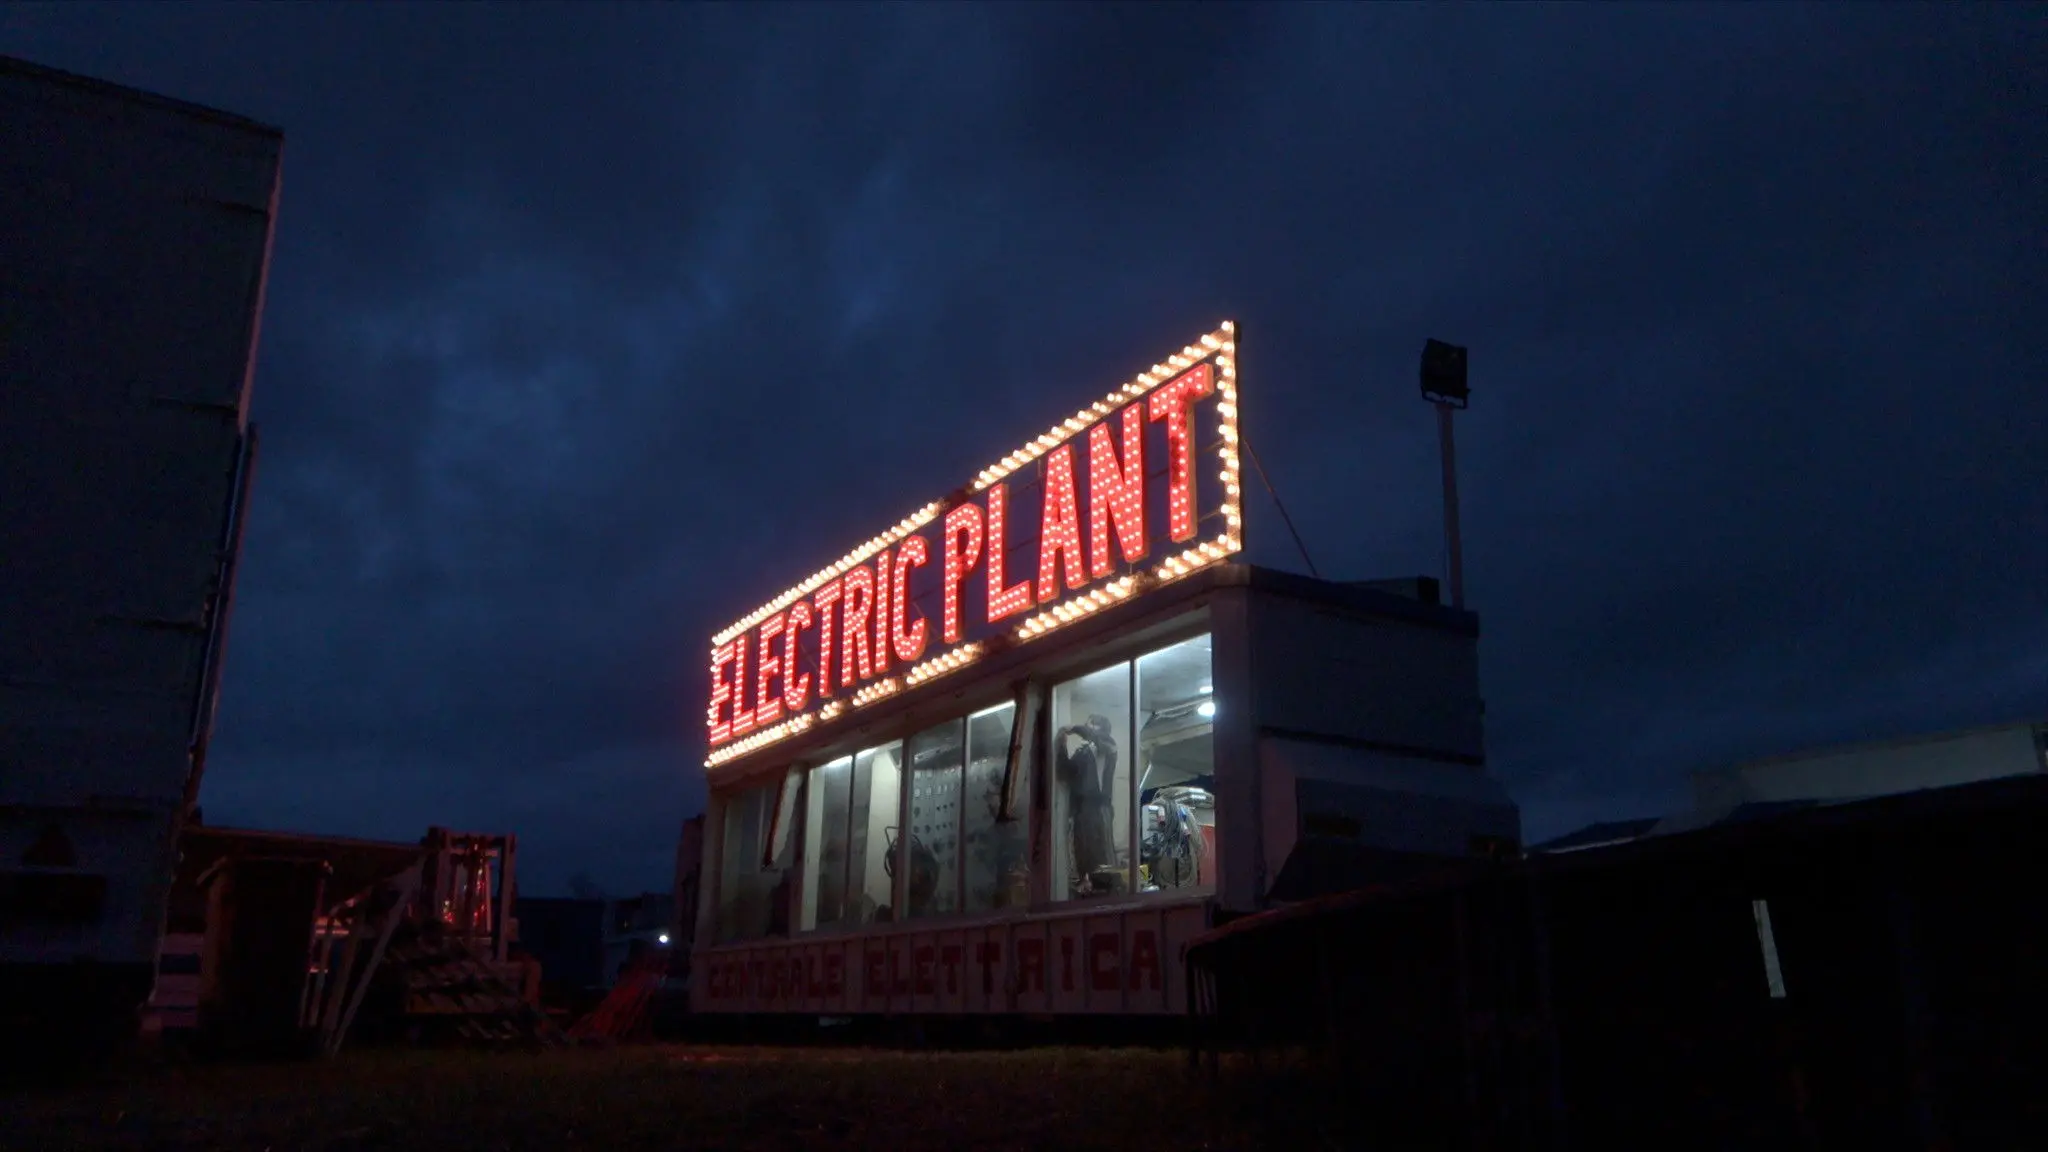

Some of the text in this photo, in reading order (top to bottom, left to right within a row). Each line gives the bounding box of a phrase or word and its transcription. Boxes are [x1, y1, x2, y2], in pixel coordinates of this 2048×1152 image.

[709, 363, 1213, 745] ELECTRIC PLANT
[708, 930, 1163, 999] CENTRALE ELETTRICA
